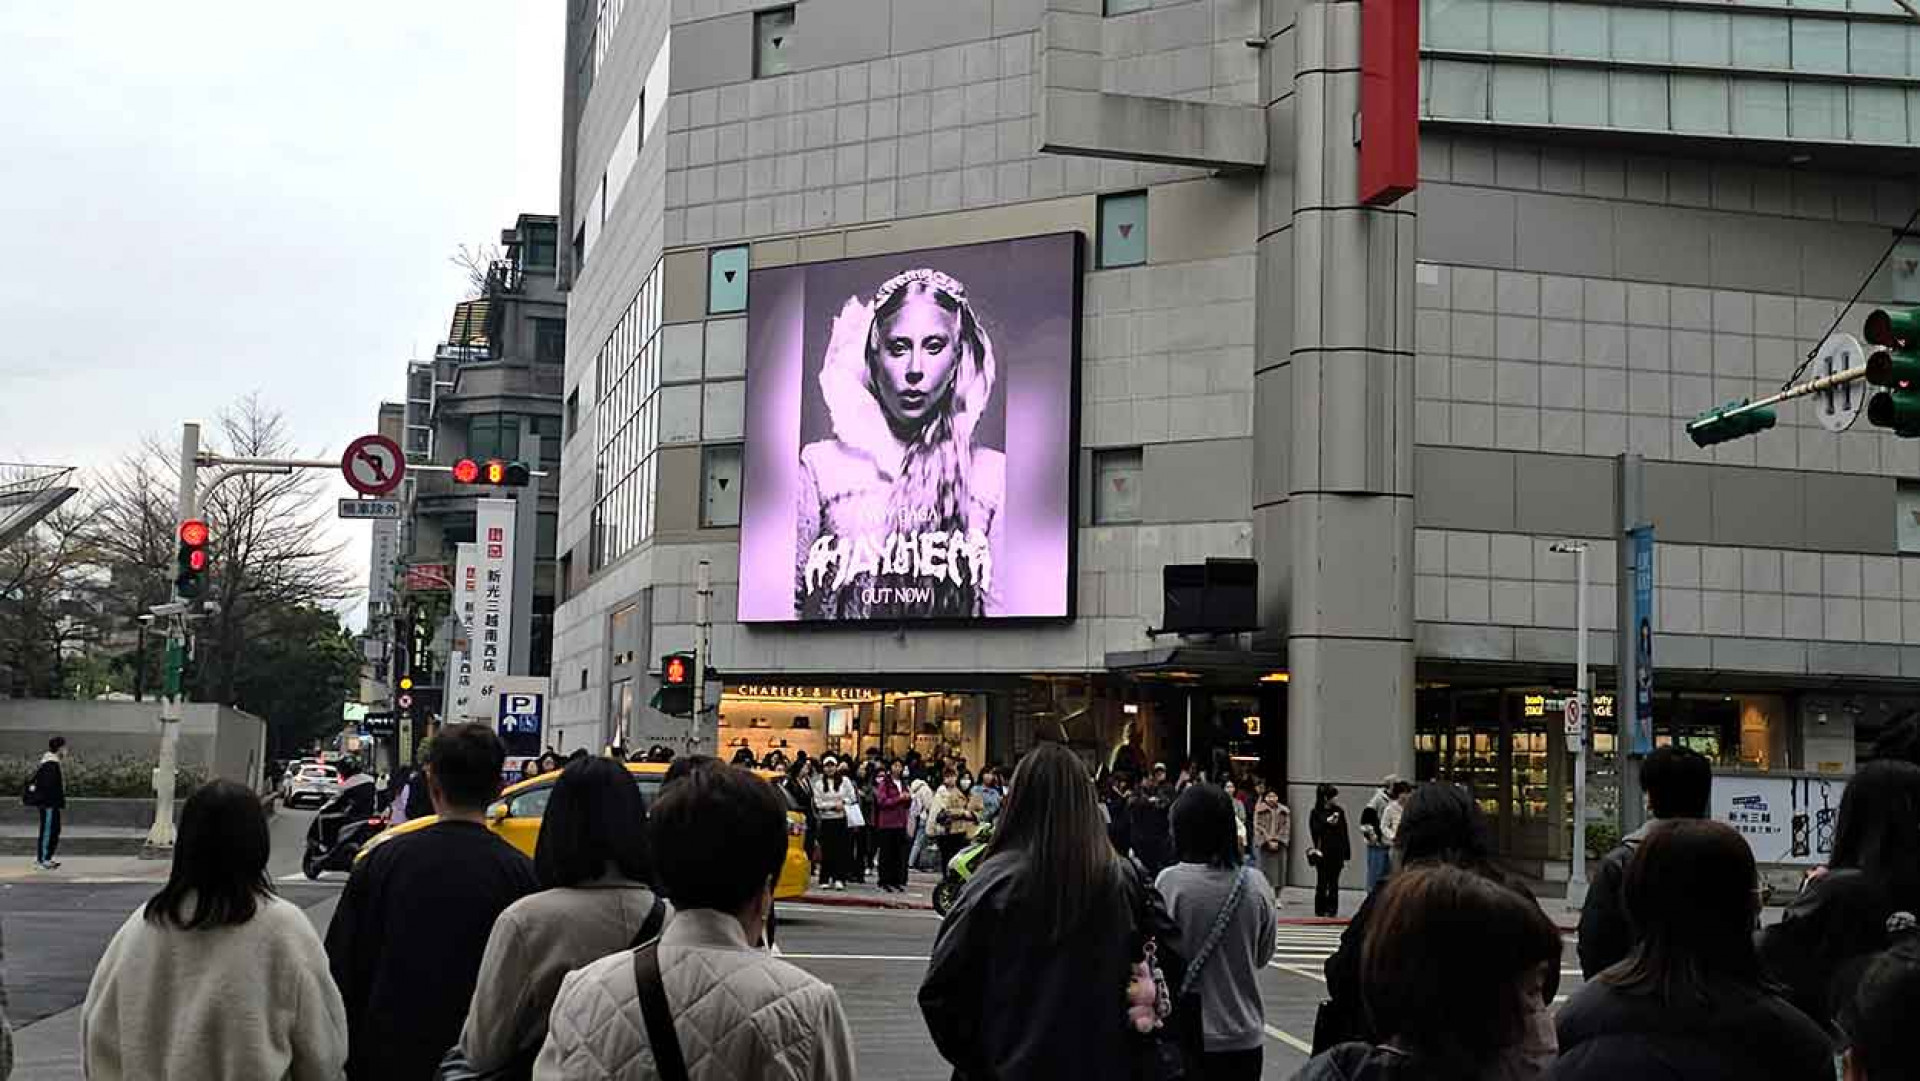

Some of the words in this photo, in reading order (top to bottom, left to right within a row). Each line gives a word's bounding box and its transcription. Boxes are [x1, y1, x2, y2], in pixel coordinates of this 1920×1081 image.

[805, 530, 991, 595] MAYHEM
[862, 587, 891, 604] OUT
[895, 586, 932, 603] NOW
[483, 570, 501, 673] 新光三越南西店
[481, 685, 495, 697] 6F
[738, 684, 804, 698] CHARLES
[812, 687, 822, 698] &
[831, 688, 872, 700] KEITH
[512, 696, 530, 712] P
